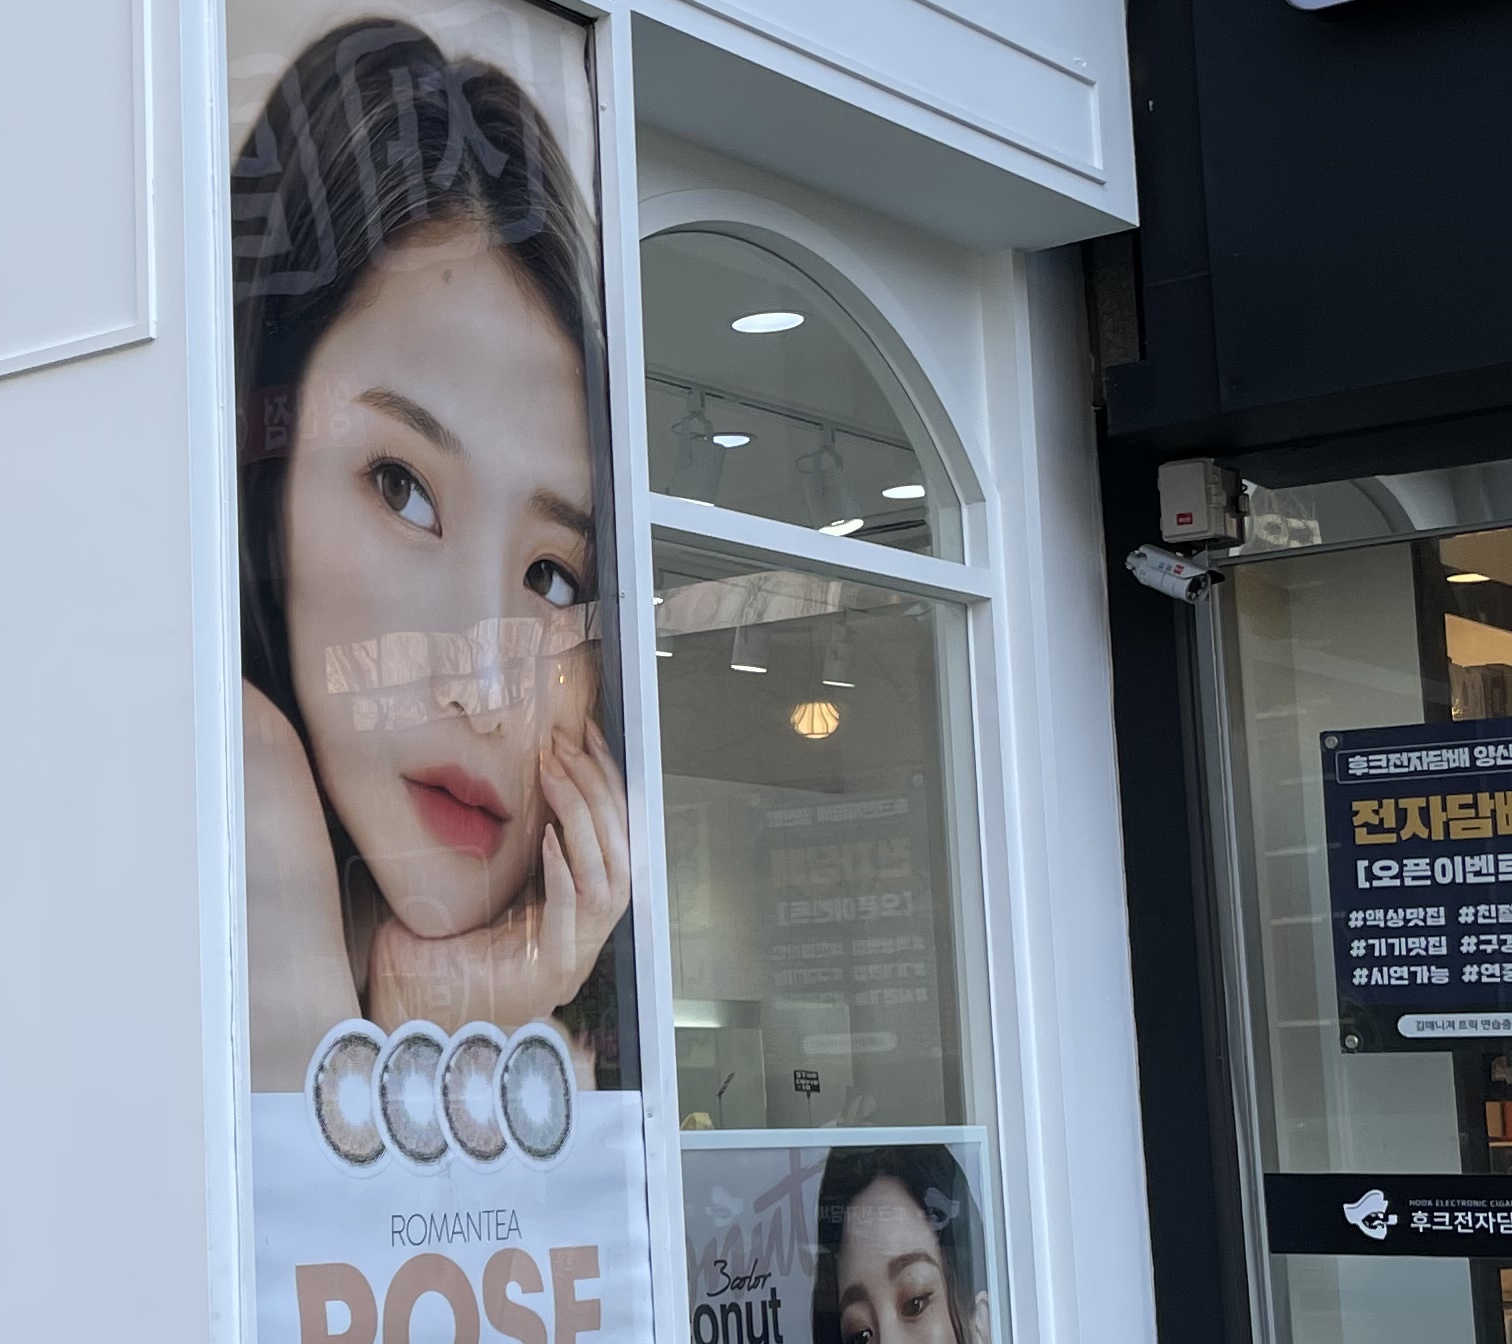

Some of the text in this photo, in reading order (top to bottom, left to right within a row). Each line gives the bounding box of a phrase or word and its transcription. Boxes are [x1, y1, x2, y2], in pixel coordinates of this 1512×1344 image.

[1348, 747, 1471, 776] 후크전자담배
[1348, 906, 1446, 928] #액상맛집
[1350, 936, 1448, 957] #기기맛집
[1352, 965, 1450, 986] #시연가능
[390, 1208, 522, 1248] ROMANTEA
